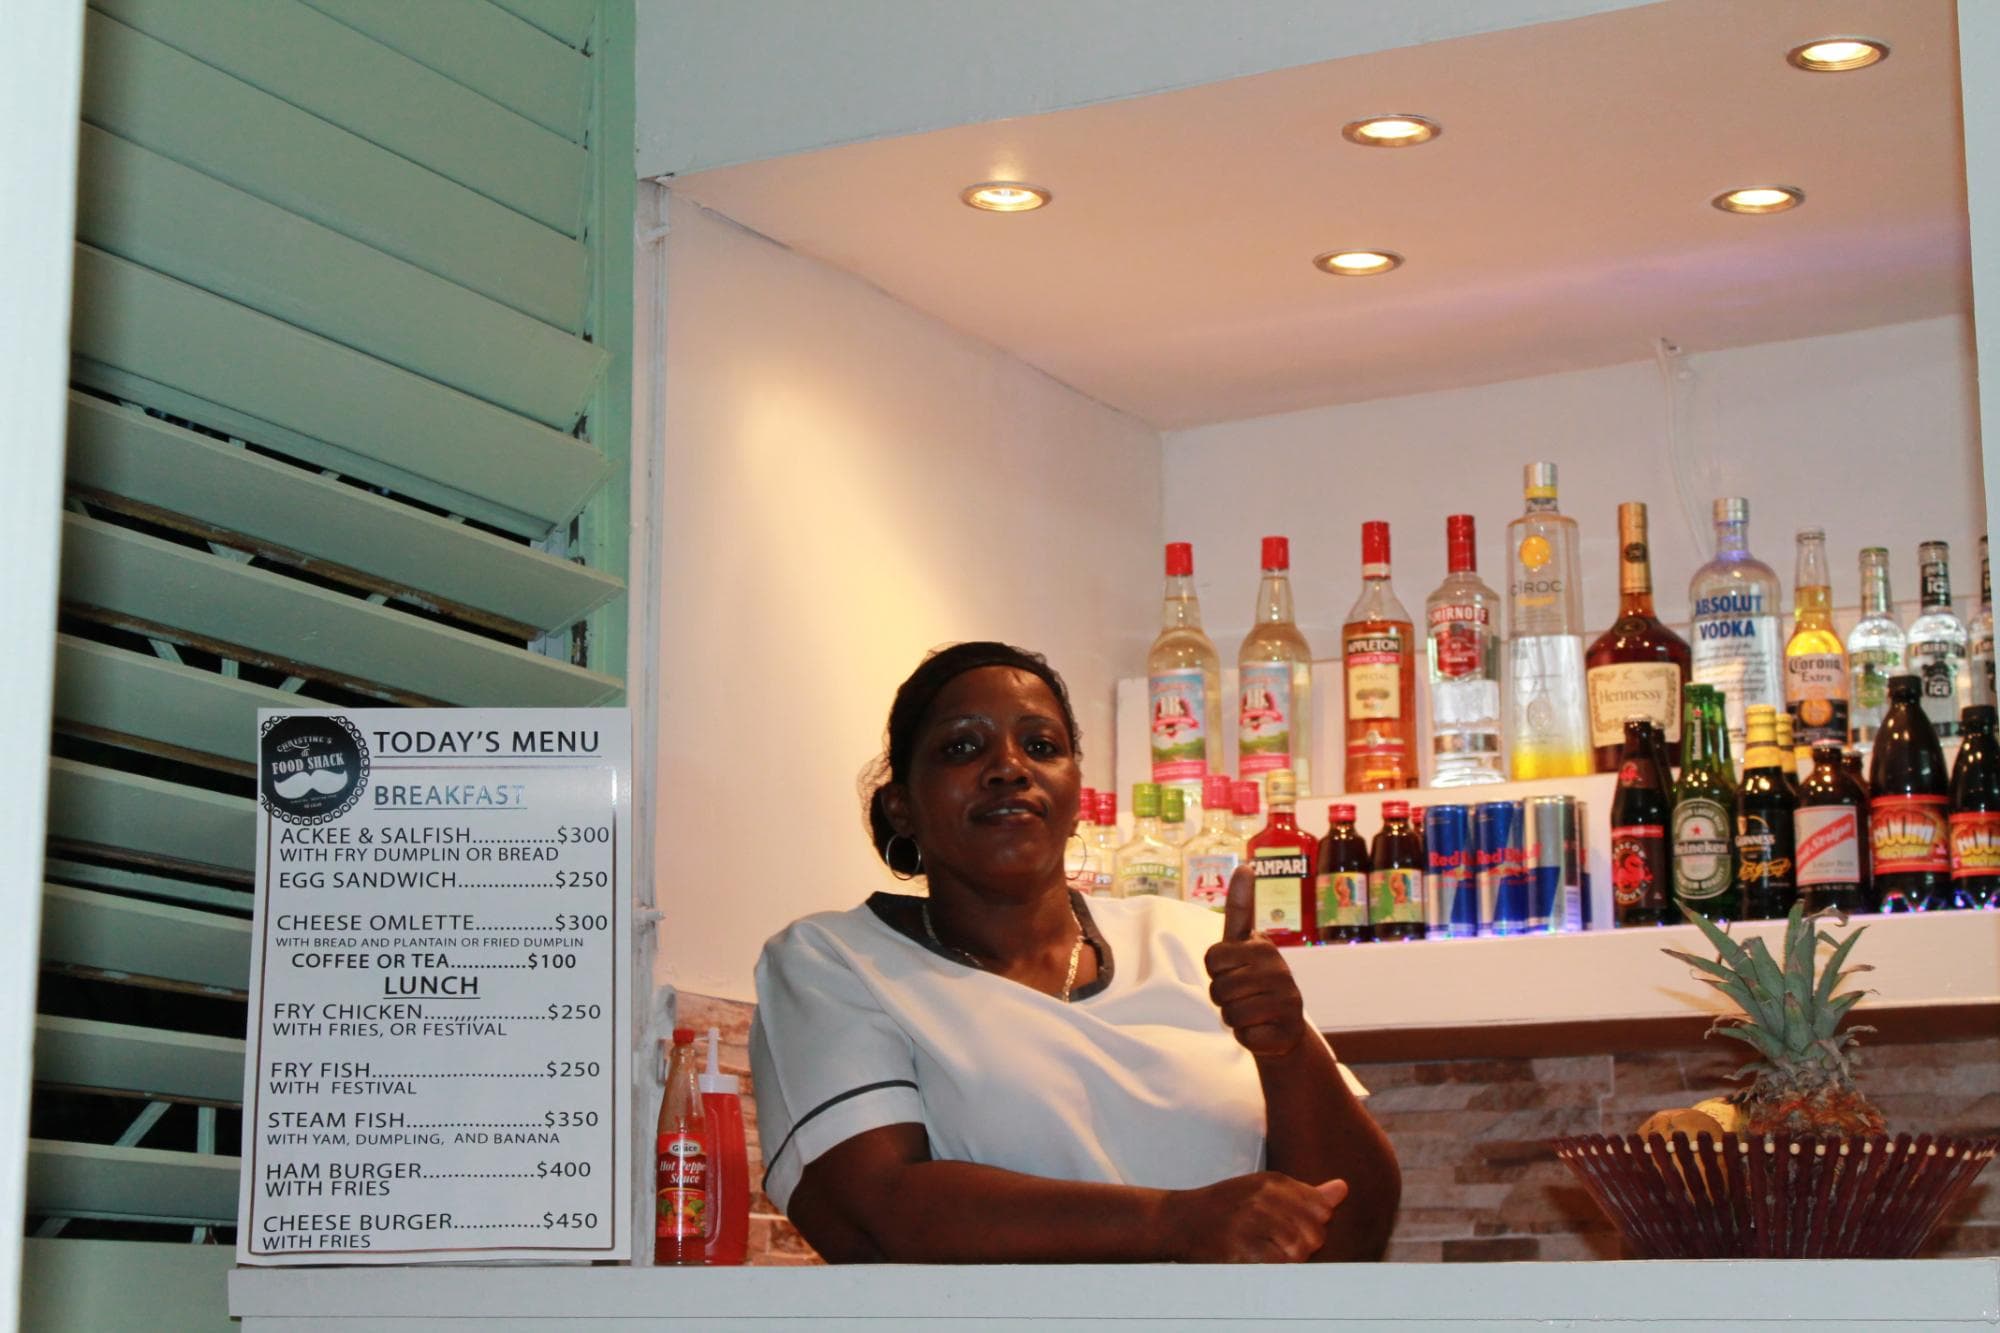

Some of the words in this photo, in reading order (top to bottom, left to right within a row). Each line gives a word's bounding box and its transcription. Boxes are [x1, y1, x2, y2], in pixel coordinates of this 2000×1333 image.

[1695, 594, 1763, 616] ABSOLUT
[1700, 620, 1756, 640] VODKA
[1348, 638, 1398, 653] APPLETON
[1789, 655, 1842, 674] Corona
[1801, 673, 1833, 683] Extra
[1600, 686, 1662, 705] Hennessy
[372, 730, 500, 754] TODAY'S
[512, 730, 599, 753] MENU
[271, 758, 305, 775] FOOD
[307, 752, 345, 770] SHACK
[373, 785, 525, 805] BREAKFAST
[280, 827, 351, 845] ACKEE
[358, 827, 374, 845] &
[557, 826, 610, 845] $300
[279, 847, 328, 862] WITH
[334, 847, 368, 862] FRY
[374, 847, 460, 862] DUMPLIN
[465, 847, 492, 862] OR
[498, 846, 559, 862] BREAD
[1428, 851, 1460, 867] Red
[1248, 858, 1307, 876] CAMPARI
[279, 871, 325, 889] EGG
[555, 870, 608, 888] $250
[276, 914, 362, 931] CHEESE
[555, 914, 608, 932] $300
[275, 937, 310, 947] WITH
[313, 937, 357, 948] BREAD
[360, 937, 390, 948] AND
[393, 937, 457, 948] PLANTAIN
[460, 937, 480, 948] OR
[483, 937, 520, 948] FRIED
[523, 937, 584, 948] DUMPLIN
[291, 952, 370, 969] COFFEE
[376, 953, 405, 969] OR
[527, 952, 577, 970] $100
[384, 975, 478, 995] LUNCH
[274, 1003, 316, 1020] FRY
[548, 1003, 601, 1021] $250
[272, 1022, 322, 1036] WITH
[328, 1022, 384, 1038] FRIES,
[389, 1022, 417, 1036] OR
[423, 1022, 507, 1037] FESTIVAL
[271, 1062, 313, 1078] FRY
[546, 1060, 600, 1078] $250
[269, 1081, 319, 1095] WITH
[331, 1081, 417, 1095] FESTIVAL
[267, 1111, 346, 1129] STEAM
[544, 1110, 599, 1129] $350
[266, 1133, 308, 1145] WITH
[312, 1133, 350, 1146] YAM,
[355, 1133, 445, 1146] DUMPLING,
[454, 1132, 489, 1144] AND
[493, 1132, 560, 1145] BANANA
[672, 1143, 698, 1152] Gace
[266, 1163, 321, 1181] HAM
[536, 1160, 591, 1179] $400
[660, 1161, 676, 1172] Hot
[680, 1160, 705, 1174] Peppe
[670, 1174, 700, 1183] Sauce
[265, 1180, 323, 1198] WITH
[331, 1180, 390, 1196] FRIES
[263, 1214, 351, 1233] CHEESE
[543, 1211, 598, 1230] $450
[262, 1235, 313, 1251] WITH
[319, 1234, 371, 1249] FRIES
